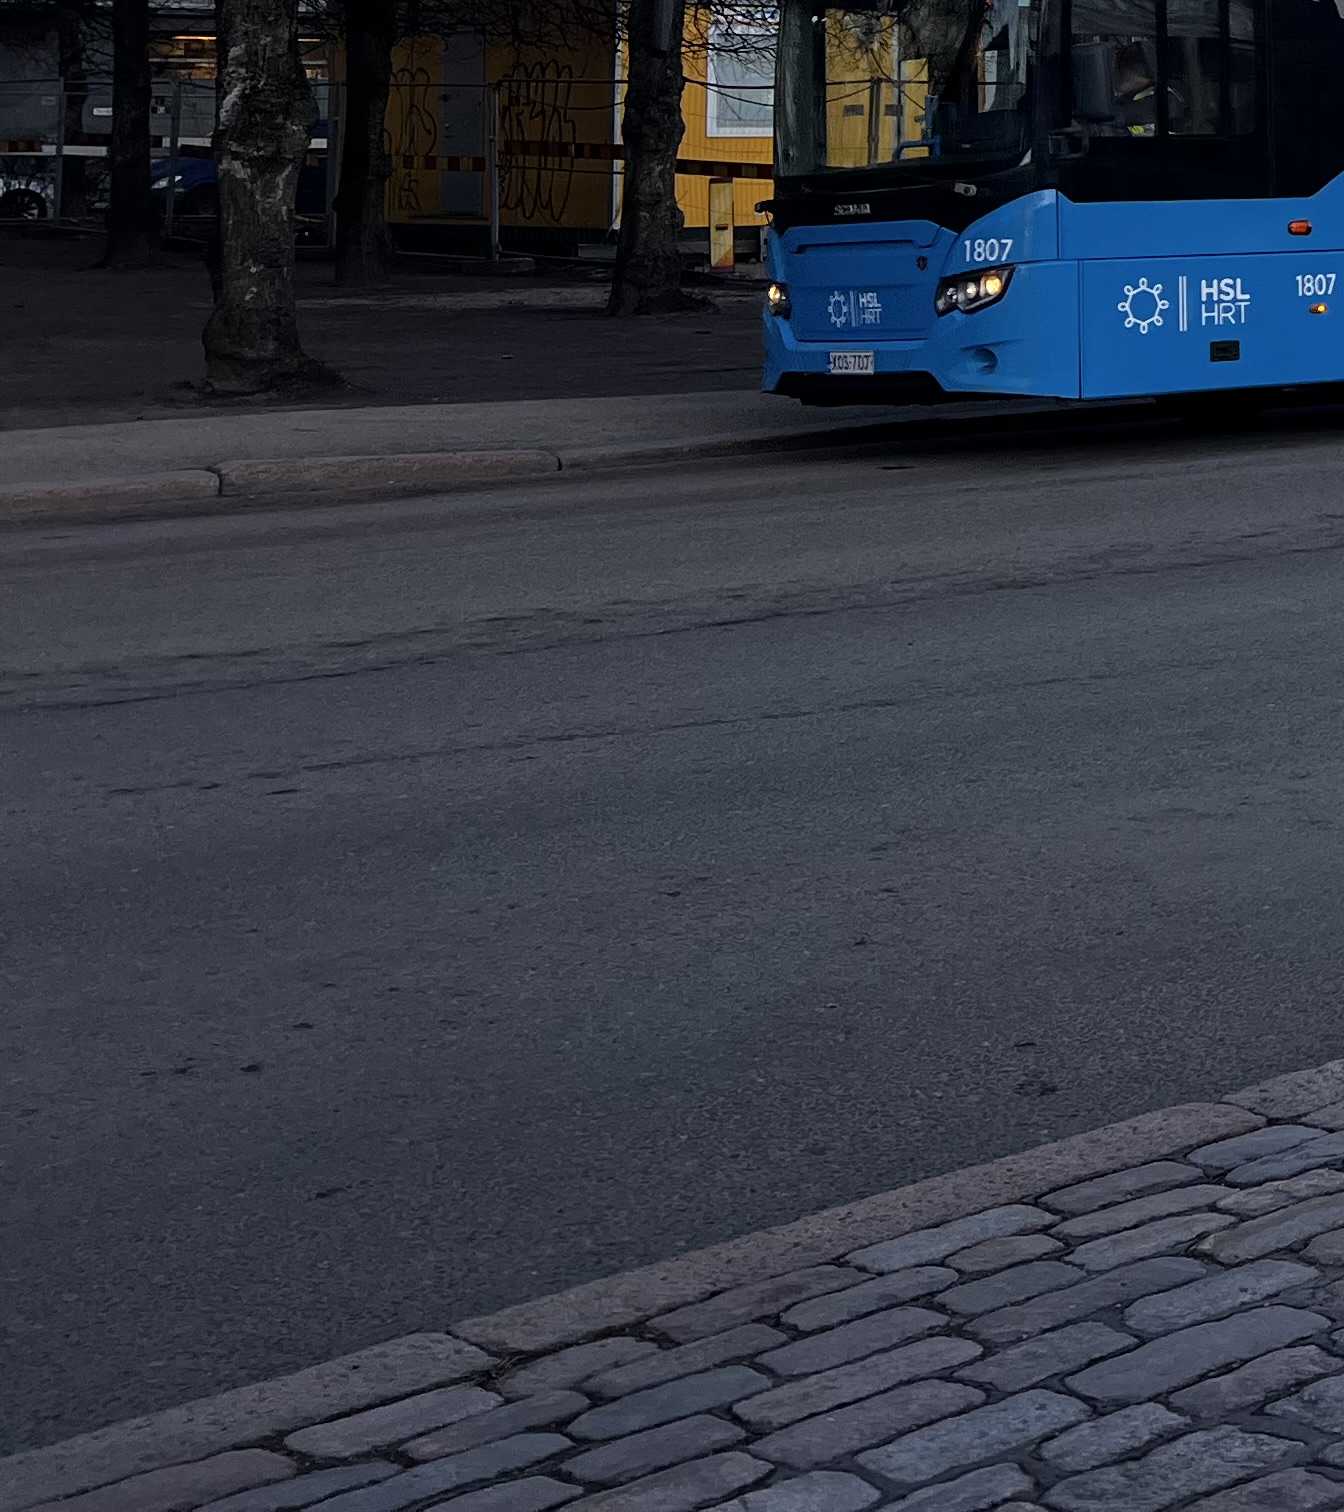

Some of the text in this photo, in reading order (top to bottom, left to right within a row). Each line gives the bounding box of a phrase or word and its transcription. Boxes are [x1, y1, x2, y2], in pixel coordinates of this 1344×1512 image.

[964, 238, 1013, 262] 1807
[1201, 277, 1250, 302] HSL
[1295, 273, 1336, 297] 1807
[858, 292, 882, 308] HSL
[860, 307, 882, 325] HRT
[1201, 302, 1250, 326] HRT
